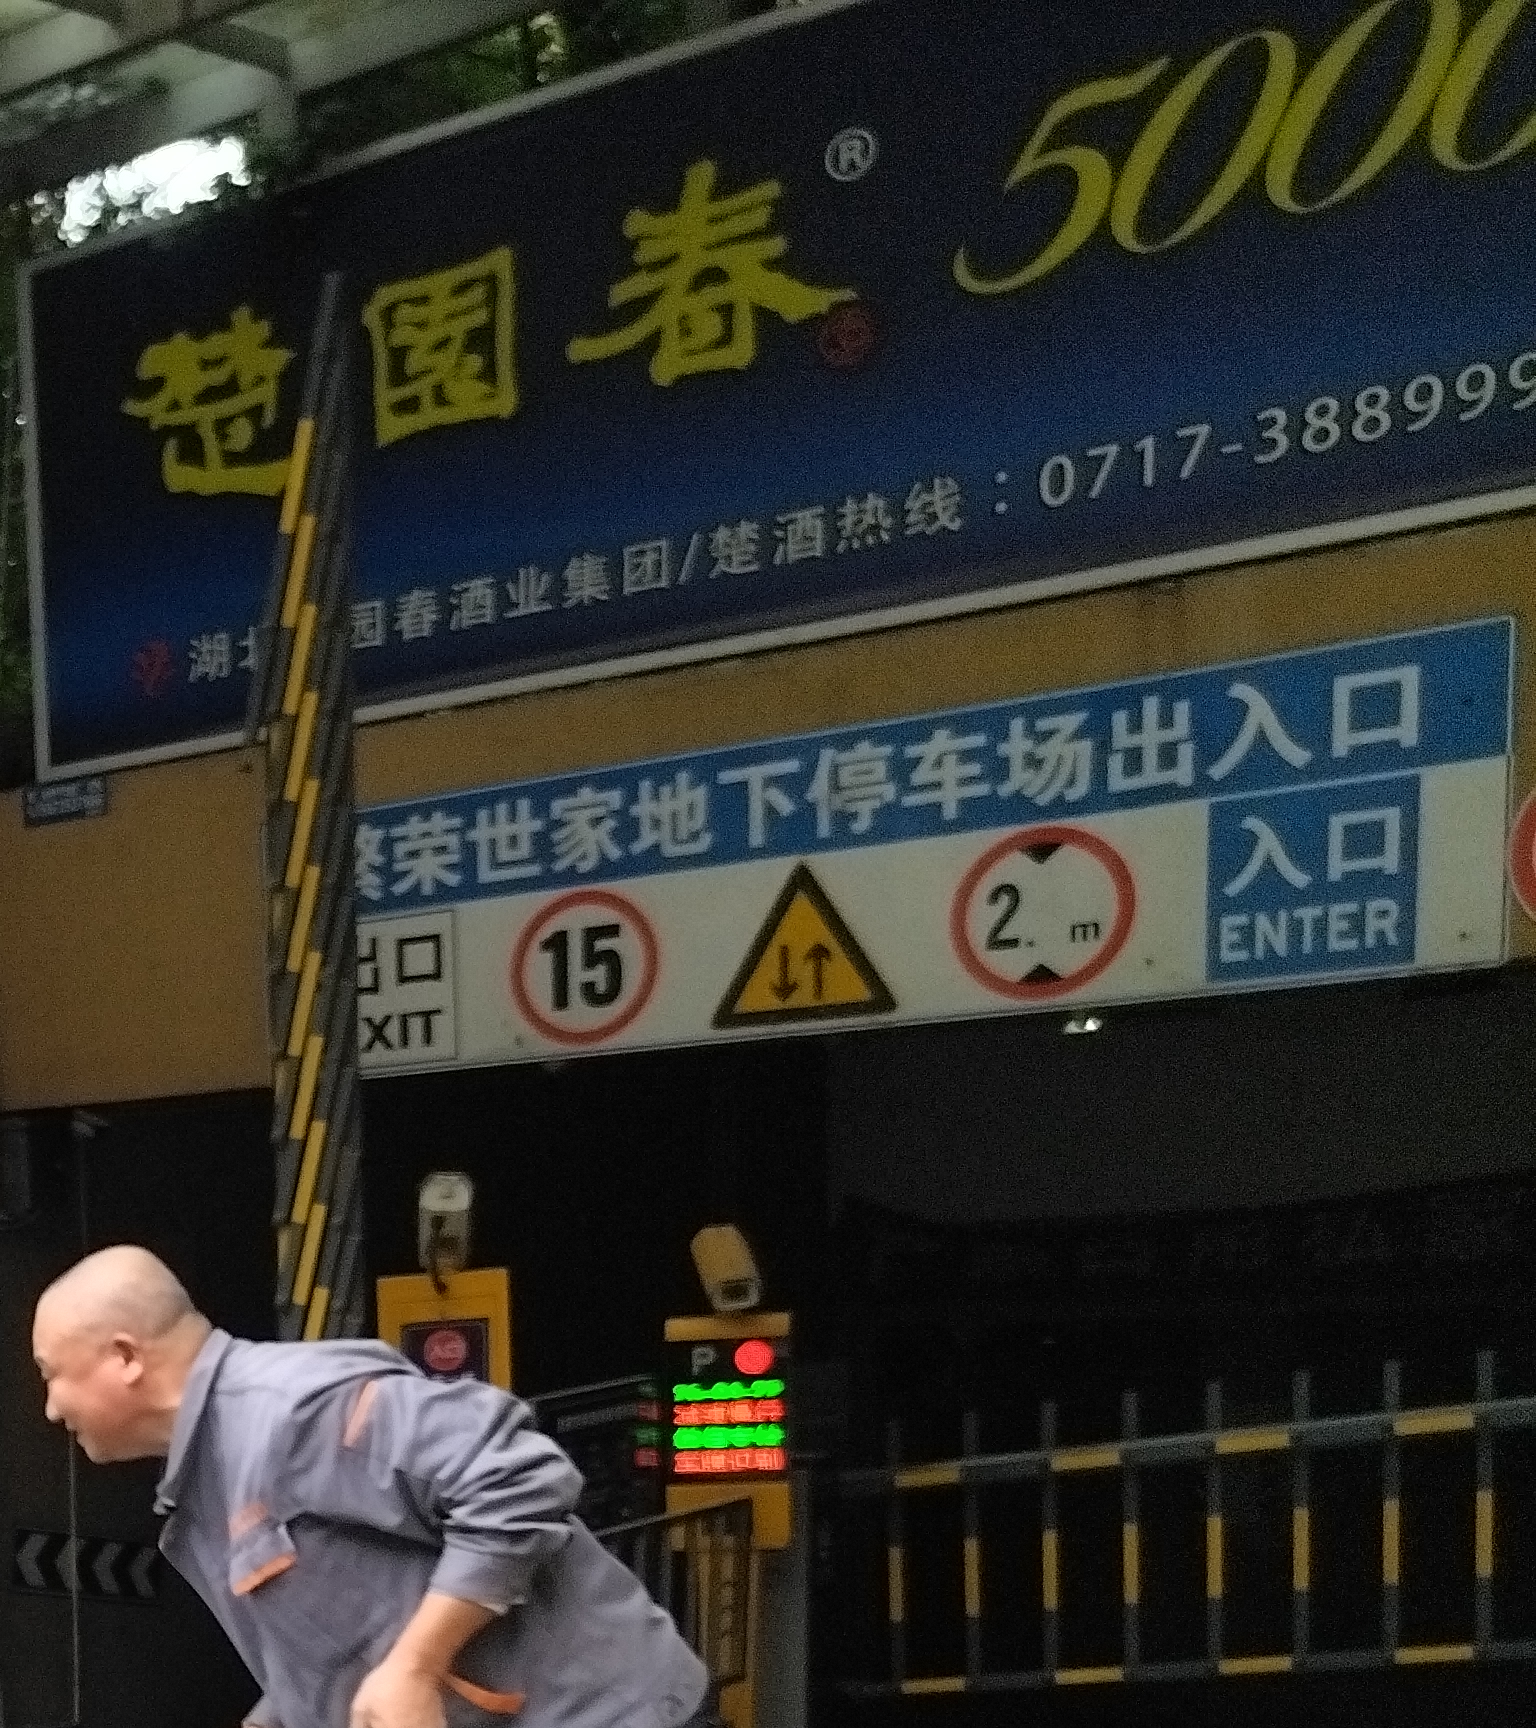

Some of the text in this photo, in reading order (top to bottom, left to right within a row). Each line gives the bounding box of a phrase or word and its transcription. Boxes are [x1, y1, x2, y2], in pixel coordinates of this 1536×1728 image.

[1220, 808, 1403, 897] 入口
[539, 924, 624, 1010] 15
[1218, 899, 1400, 965] ENTER
[362, 1010, 441, 1051] XIT
